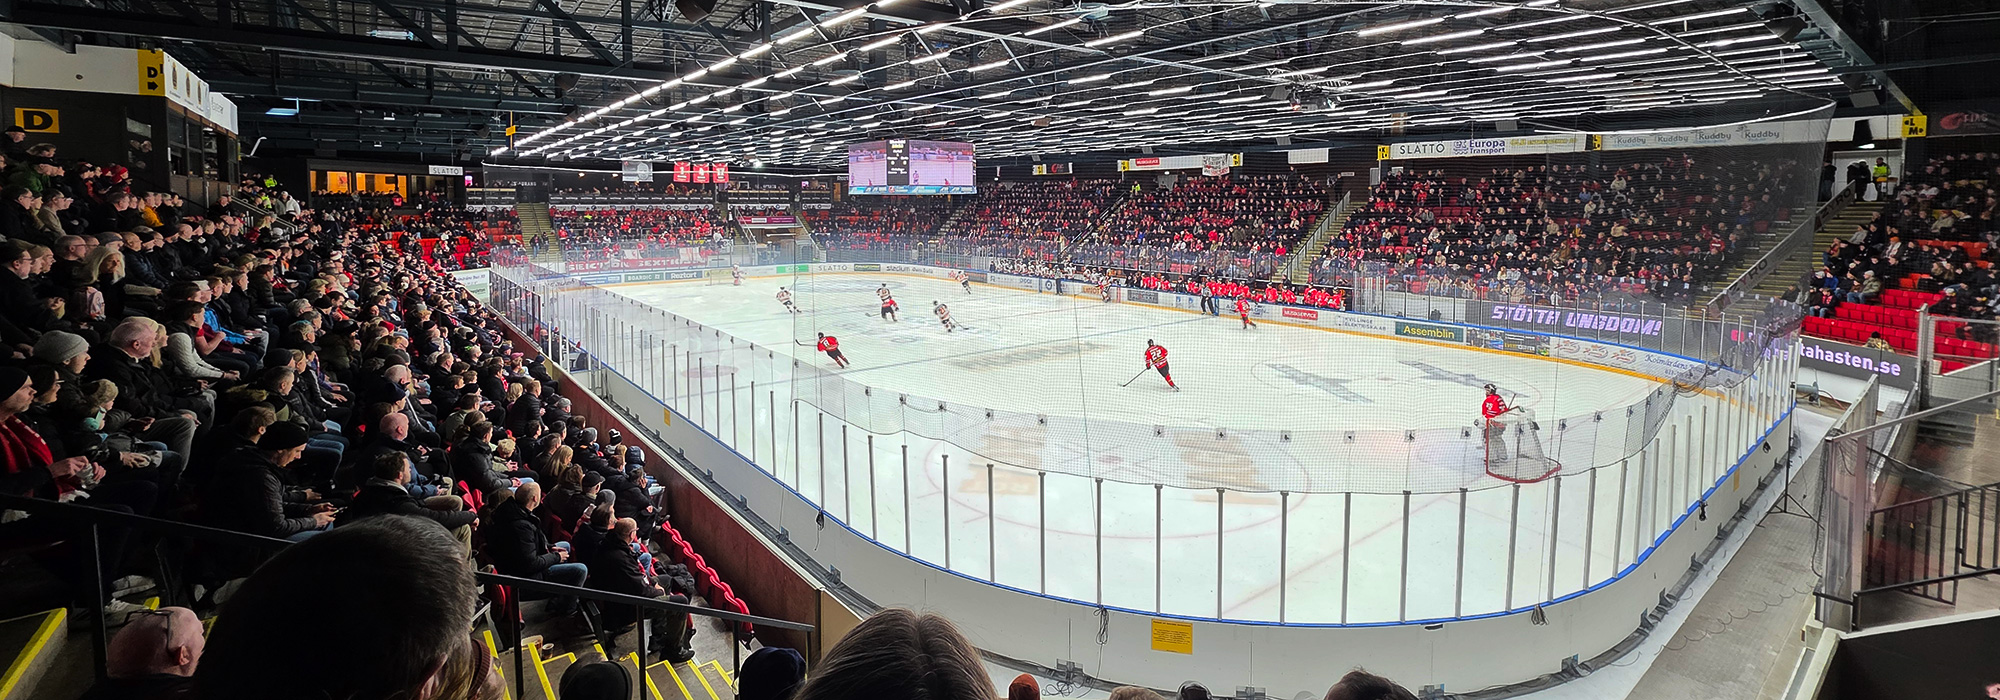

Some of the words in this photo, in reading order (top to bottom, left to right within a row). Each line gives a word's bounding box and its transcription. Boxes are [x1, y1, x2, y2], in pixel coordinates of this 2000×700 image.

[147, 66, 158, 78] D
[23, 110, 54, 130] D
[1910, 118, 1915, 126] L
[1745, 130, 1780, 138] Kuddby
[1908, 127, 1918, 135] M
[1617, 136, 1647, 144] Kuddby
[1657, 134, 1689, 142] Kuddby
[1699, 131, 1732, 141] Kuddby
[1470, 140, 1505, 148] Europa
[1492, 304, 1561, 325] STÖTTA
[1565, 312, 1663, 336] UNGDOM!
[1403, 325, 1455, 339] Assemblin
[1150, 348, 1162, 361] 22
